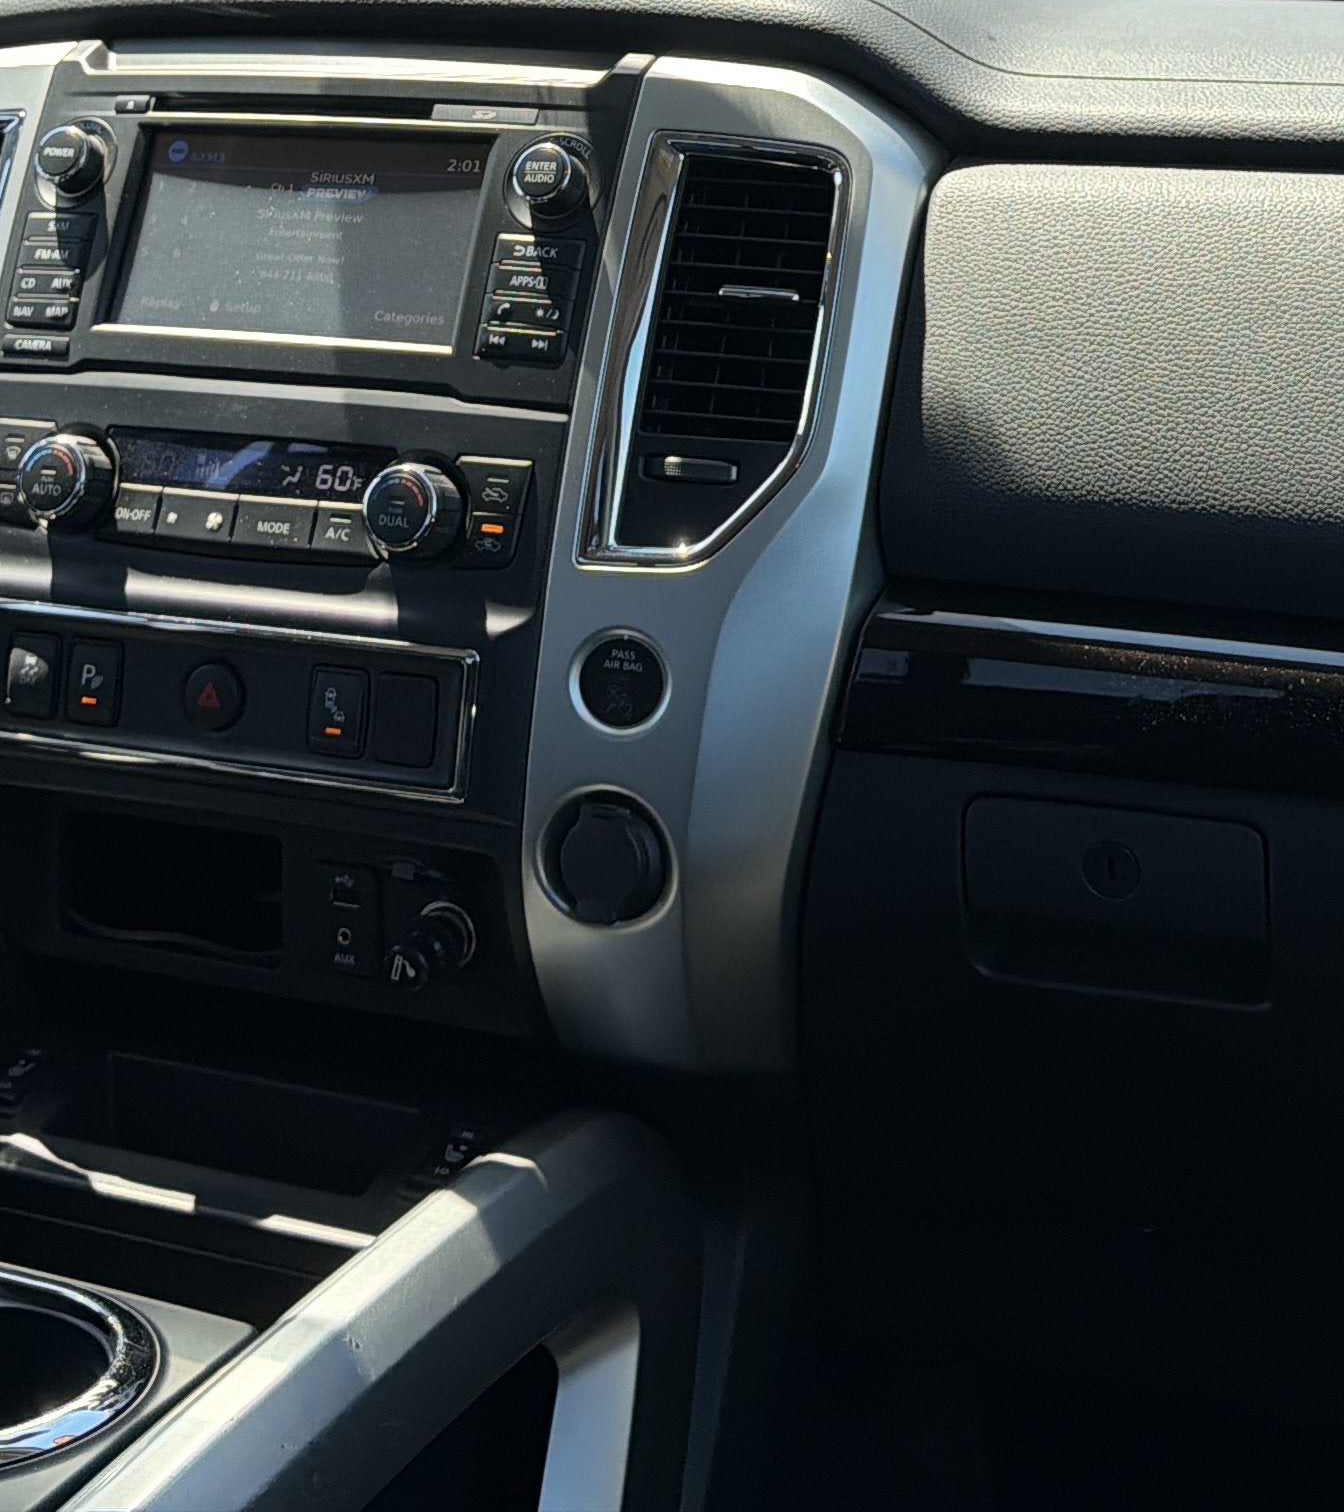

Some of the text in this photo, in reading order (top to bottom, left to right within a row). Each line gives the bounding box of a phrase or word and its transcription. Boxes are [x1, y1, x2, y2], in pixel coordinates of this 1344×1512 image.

[43, 146, 75, 158] POWER
[559, 136, 593, 160] SCROLL
[447, 159, 481, 173] 2:01
[525, 161, 557, 171] ENTER
[524, 173, 555, 183] AUDIO
[307, 188, 367, 200] PREVIEW
[256, 208, 364, 224] SiriusXM Preview
[47, 220, 70, 232] SXM
[526, 245, 559, 258] BACK
[20, 276, 74, 289] CD AUX
[13, 306, 68, 318] NAV MAP
[374, 310, 445, 326] Categories
[14, 339, 52, 351] CAMERA
[31, 482, 62, 496] AUTO
[257, 520, 291, 535] MODE
[378, 515, 409, 528] DUAL
[325, 527, 350, 542] A/C
[611, 648, 636, 660] PASS
[603, 659, 644, 673] AIR BAG
[81, 663, 96, 685] P
[334, 953, 356, 965] AUX
